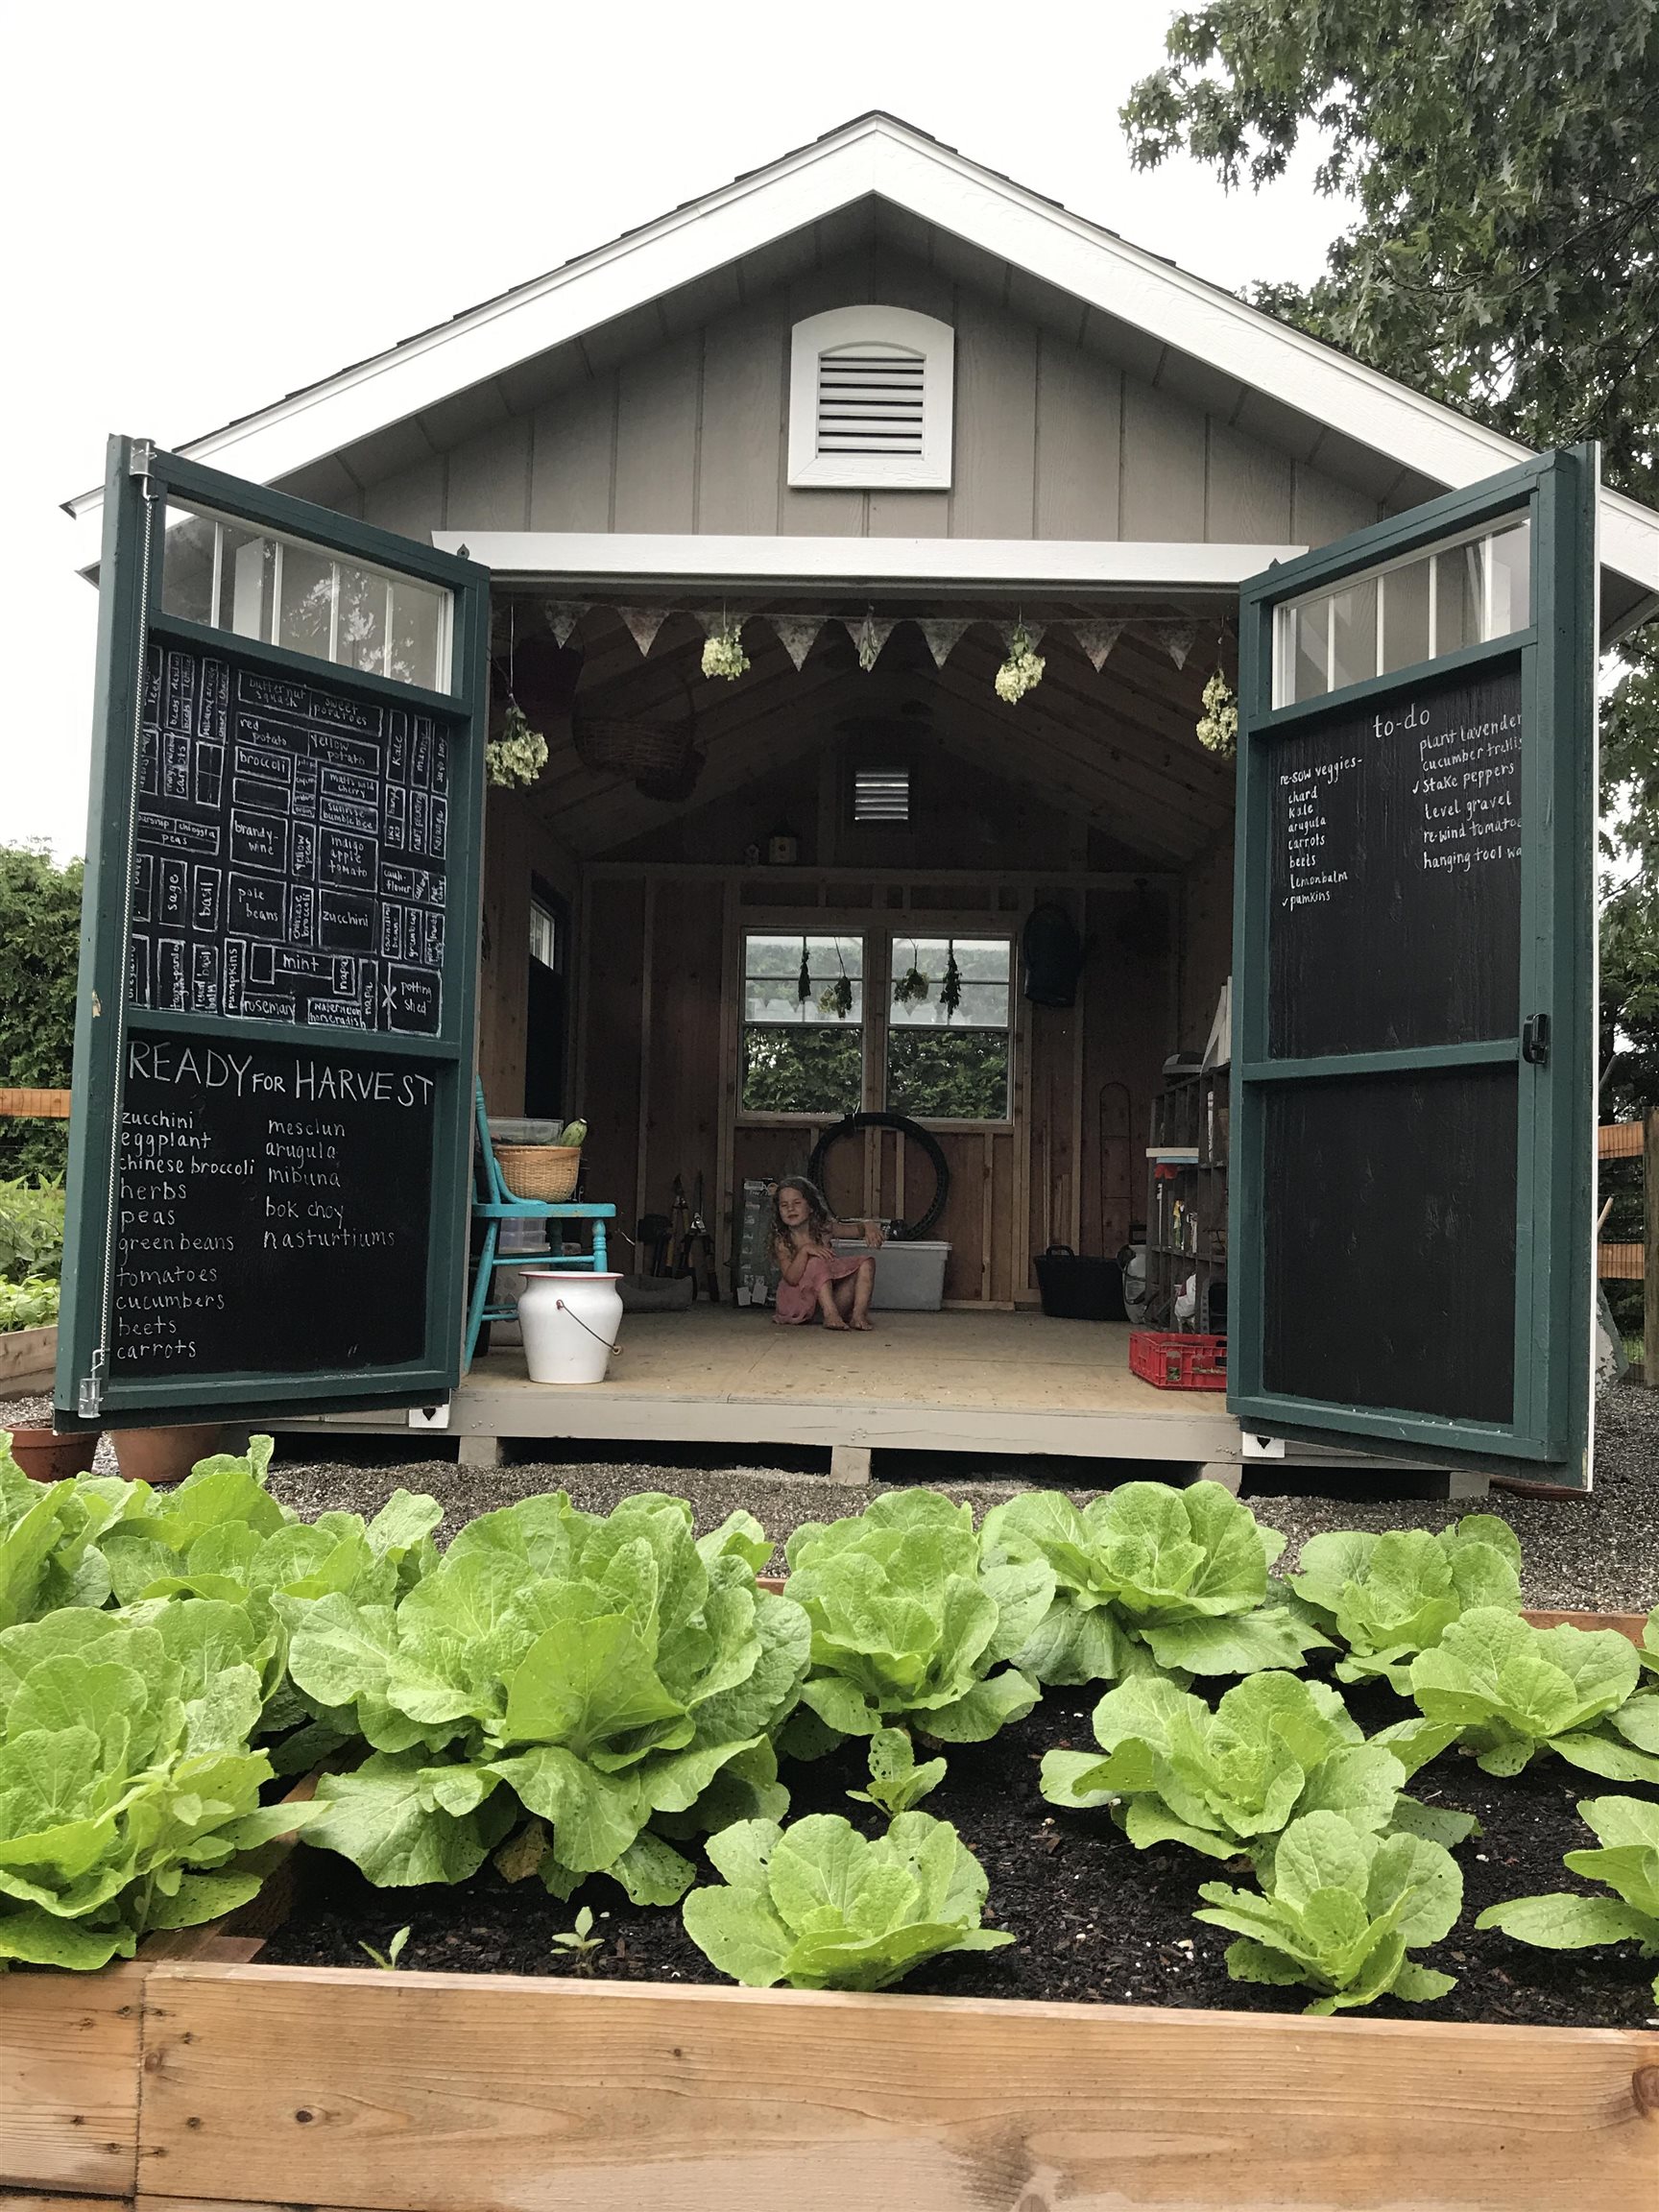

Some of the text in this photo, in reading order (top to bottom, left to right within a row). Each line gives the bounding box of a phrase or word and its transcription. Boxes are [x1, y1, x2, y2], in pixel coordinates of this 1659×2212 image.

[256, 690, 298, 708] squash
[325, 697, 358, 715] sweet
[240, 718, 259, 732] red
[313, 704, 368, 726] potatoes
[1372, 703, 1431, 738] to-do
[252, 733, 287, 746] potato
[1419, 713, 1522, 762] plant lavender
[239, 752, 285, 773] broccoli
[327, 751, 366, 766] potato
[1422, 747, 1484, 772] cucumber
[1280, 768, 1311, 786] re-sow
[1463, 762, 1515, 789] peppers
[1288, 785, 1318, 804] chard
[1466, 791, 1512, 821] gravel
[1287, 816, 1327, 835] arugula
[1423, 823, 1467, 844] re-wind
[161, 834, 187, 846] peas
[249, 841, 274, 855] wine
[330, 835, 364, 855] indigo
[1287, 833, 1326, 851] carrots
[331, 849, 362, 864] apple
[1289, 854, 1316, 868] beets
[1423, 851, 1471, 873] hanging
[1473, 845, 1502, 861] tool
[1289, 871, 1348, 890] lemonbalm
[167, 874, 181, 911] sage
[199, 882, 214, 917] basil
[237, 887, 265, 902] pole
[1289, 890, 1331, 912] pumkins
[246, 902, 278, 922] beans
[323, 909, 369, 927] zucchini
[282, 953, 320, 972] mint
[228, 948, 239, 1009] pumpkins
[340, 958, 349, 990] napa
[364, 981, 373, 1016] napa
[400, 981, 432, 1002] potting
[404, 998, 426, 1015] shed
[127, 1041, 434, 1107] READY FOR HARVEST
[122, 1110, 193, 1129] zucchini
[268, 1118, 346, 1137] mesclun
[121, 1132, 211, 1157] eggplant
[119, 1154, 255, 1175] chinese broccoli
[266, 1142, 337, 1169] arugula
[268, 1166, 341, 1188] mibuna
[120, 1177, 187, 1200] herbs
[121, 1209, 176, 1234] peas
[266, 1195, 344, 1229] bok choy
[263, 1228, 396, 1249] nasturtiums
[116, 1265, 217, 1286] tomatoes
[116, 1291, 225, 1310] cucumbers
[118, 1315, 178, 1337] beets
[117, 1339, 197, 1359] carrots
